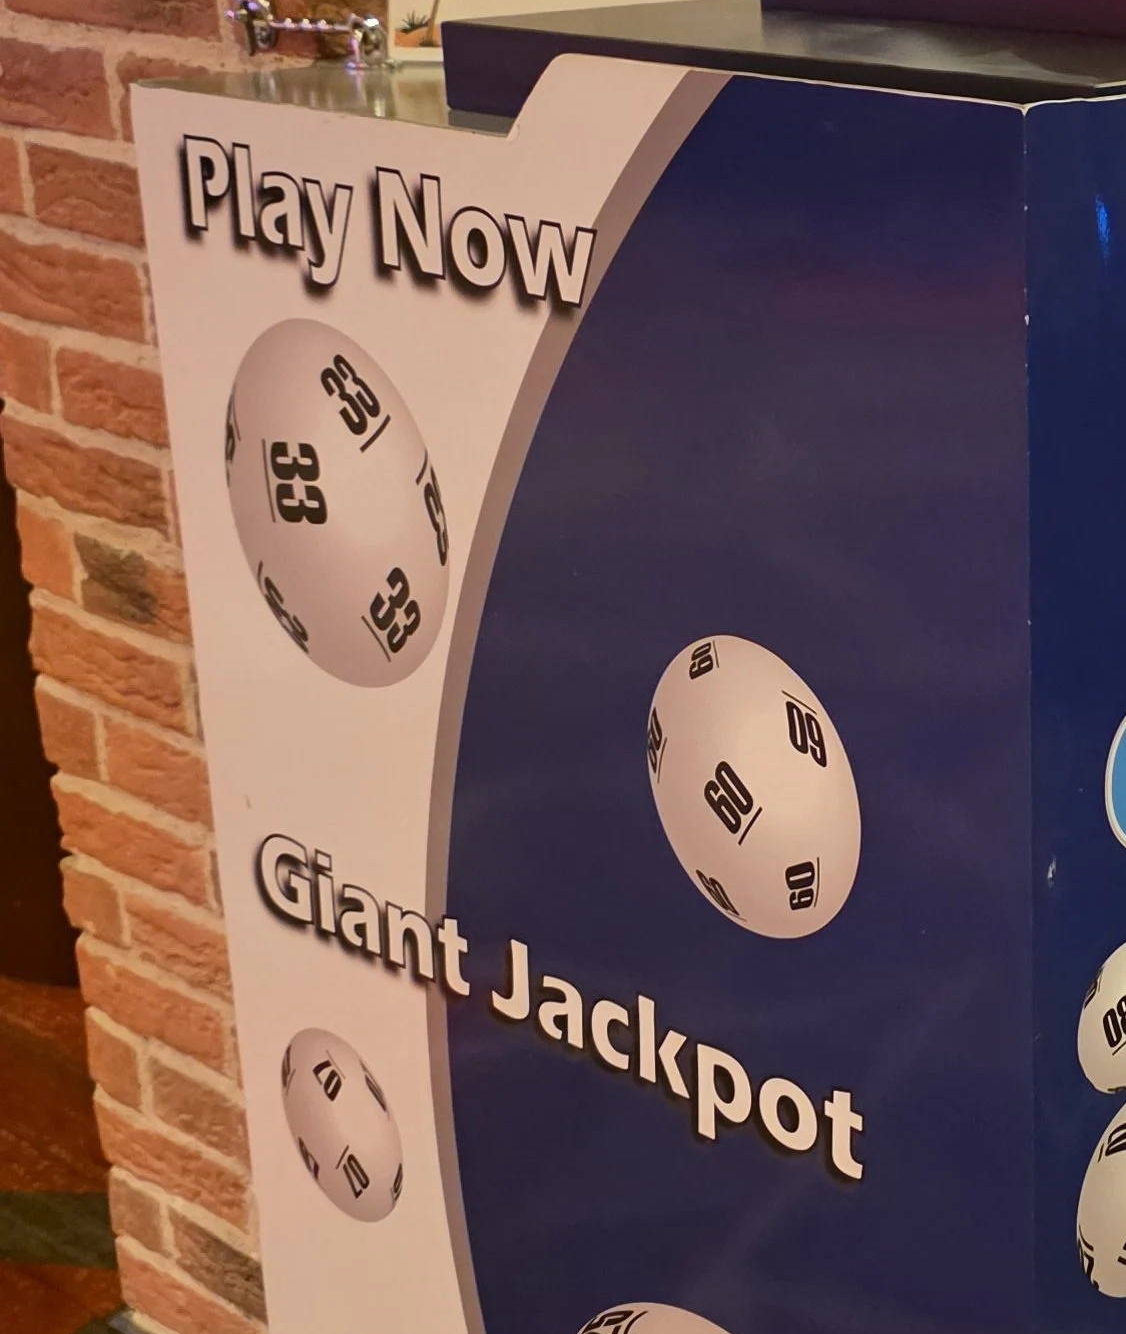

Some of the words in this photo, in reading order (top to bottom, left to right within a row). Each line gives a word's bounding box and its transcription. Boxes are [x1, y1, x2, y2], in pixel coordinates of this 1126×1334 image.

[182, 134, 353, 287] Play
[372, 166, 597, 308] Now
[320, 354, 381, 435] 33
[270, 441, 329, 525] 33
[369, 567, 421, 653] 33
[689, 642, 713, 680] 60
[704, 761, 754, 834] 60
[785, 861, 815, 911] 60
[256, 833, 471, 997] Giant
[491, 939, 863, 1180] Jackpot
